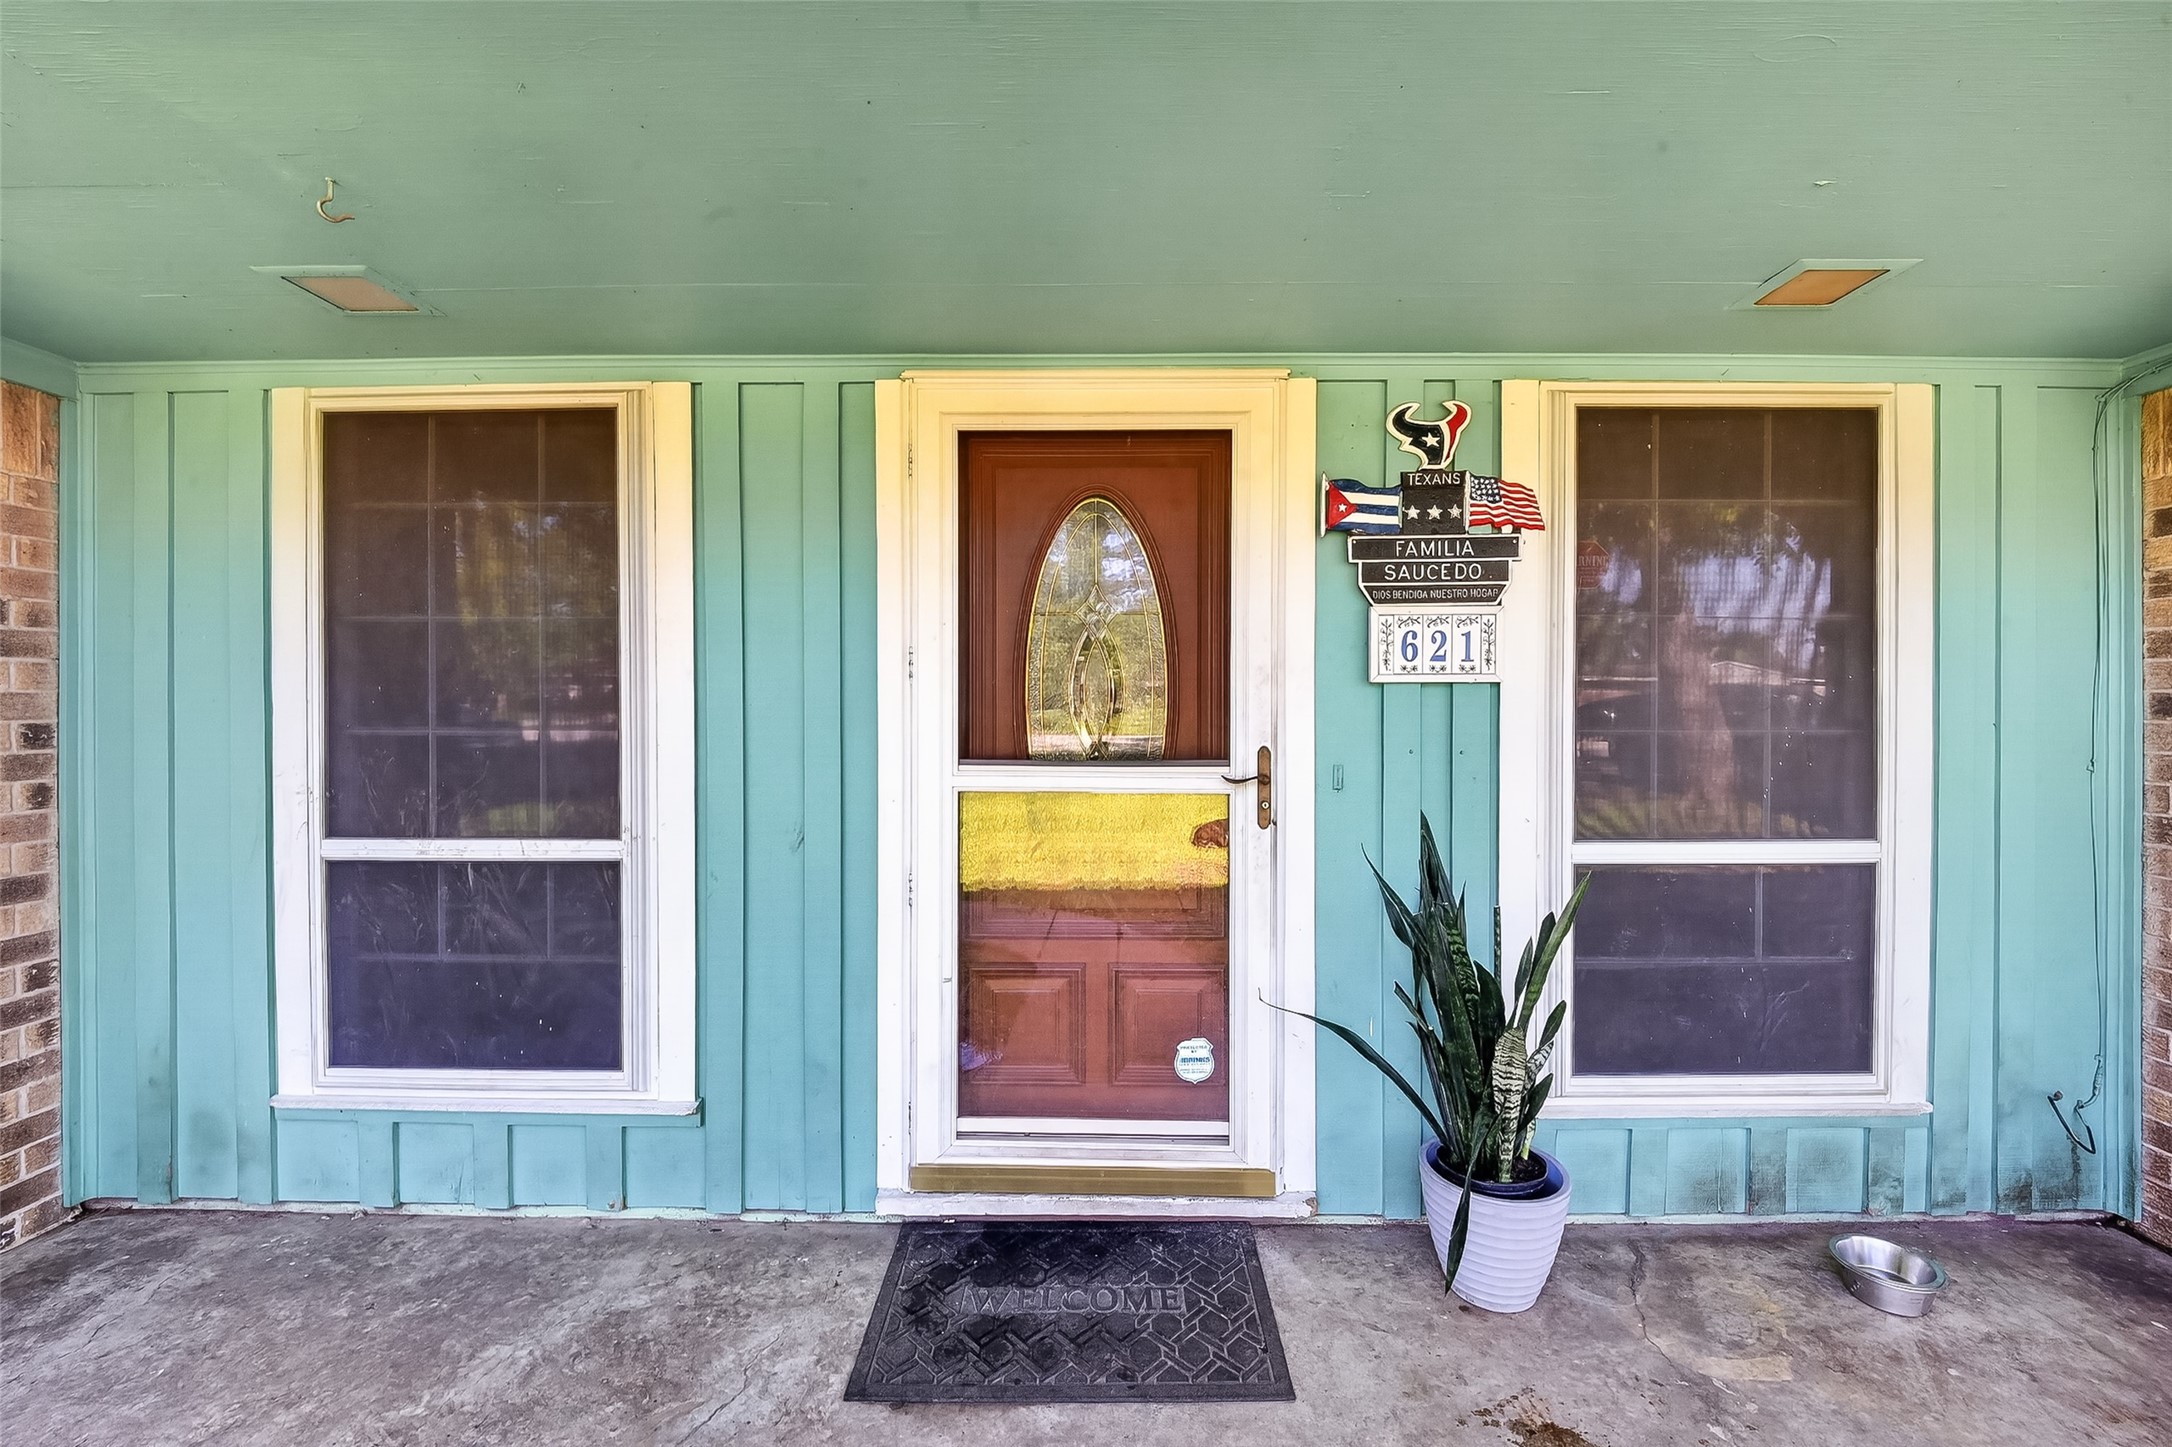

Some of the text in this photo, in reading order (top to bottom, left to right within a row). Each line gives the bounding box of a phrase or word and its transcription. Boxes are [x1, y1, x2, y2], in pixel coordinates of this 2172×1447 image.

[1407, 472, 1461, 486] TEXANS
[1395, 540, 1475, 557] FAMILIA
[1384, 563, 1482, 581] SAUCEDO
[1372, 590, 1391, 600] DIOS
[1430, 589, 1468, 599] NUESTRO
[1470, 588, 1498, 599] HOGAR
[1400, 629, 1475, 662] 621
[964, 1287, 1181, 1312] WELCOME
